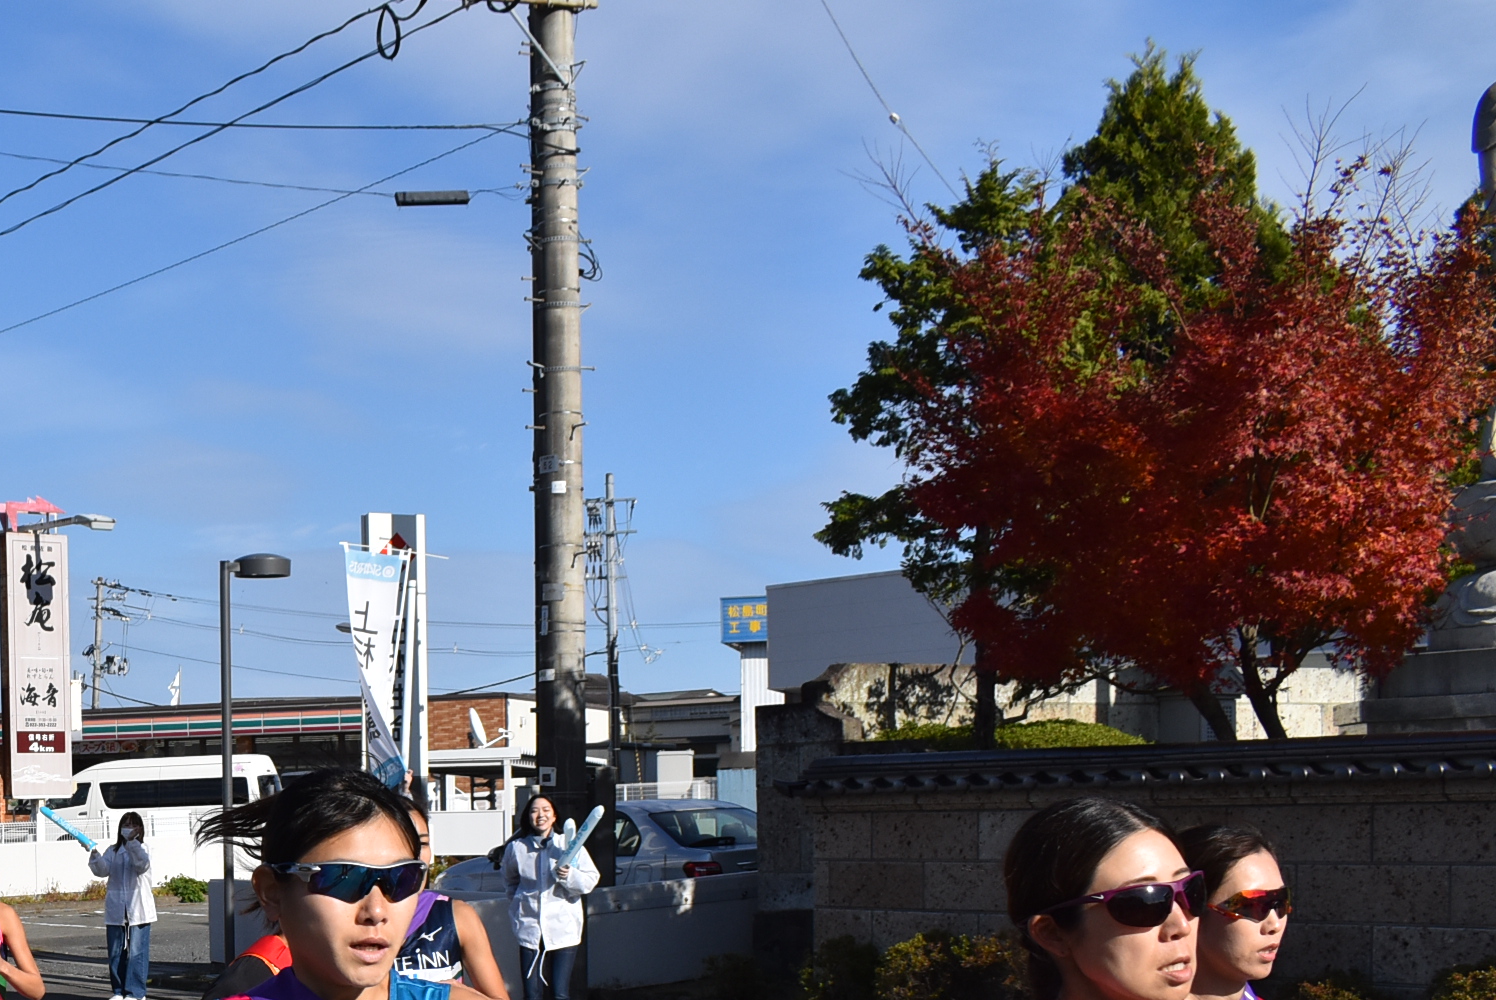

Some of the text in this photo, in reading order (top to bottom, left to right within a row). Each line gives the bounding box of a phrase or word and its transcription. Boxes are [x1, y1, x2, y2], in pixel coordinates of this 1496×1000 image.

[28, 733, 55, 742] 信号右折
[28, 741, 55, 753] 4km
